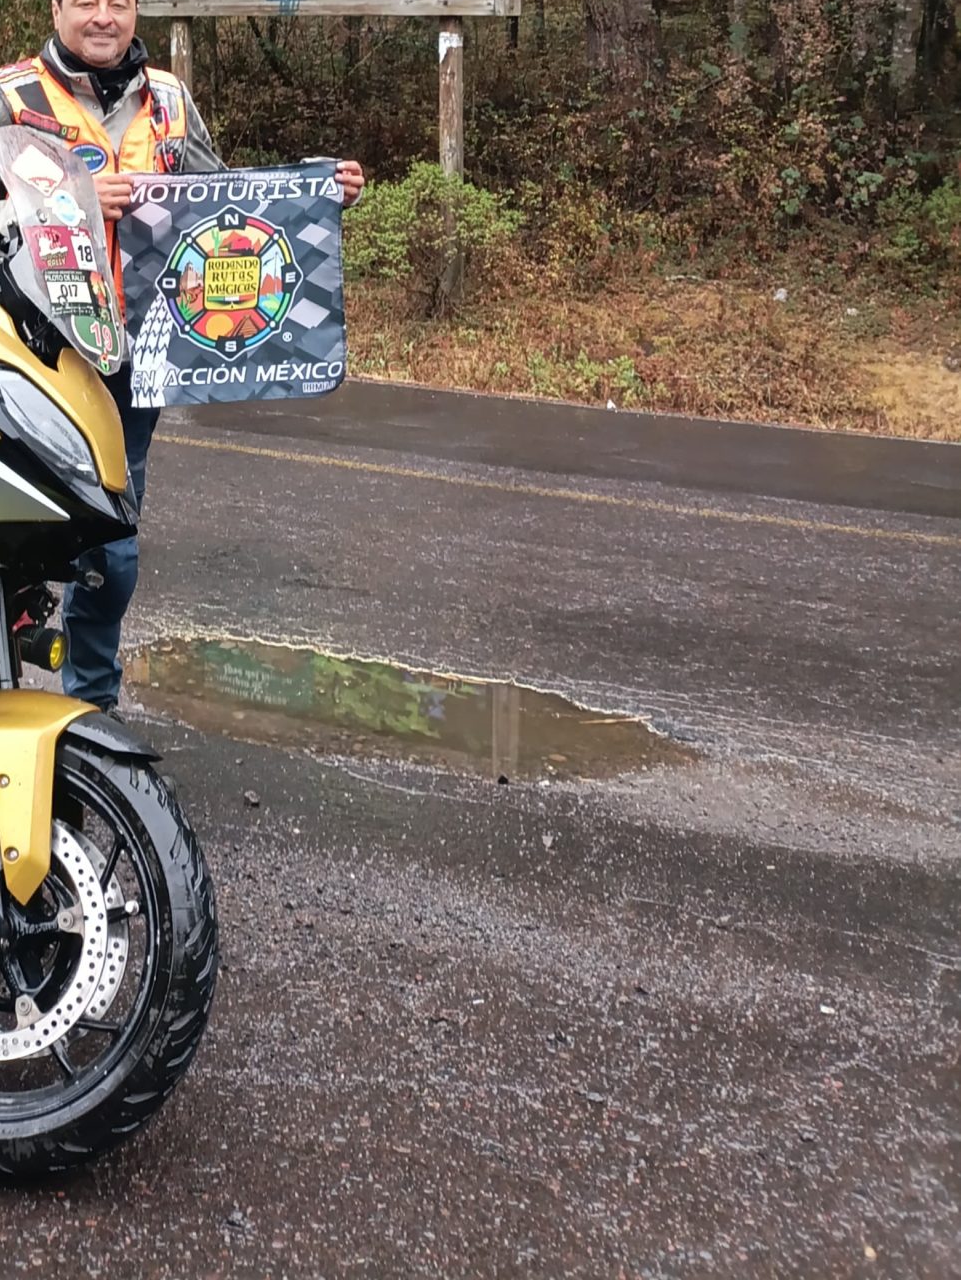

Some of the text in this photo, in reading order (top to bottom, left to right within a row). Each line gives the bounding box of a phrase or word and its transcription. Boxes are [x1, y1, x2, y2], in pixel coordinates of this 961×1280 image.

[130, 176, 340, 203] MOTOTURISTA
[224, 213, 239, 226] N
[78, 245, 93, 262] 18
[285, 272, 296, 283] E
[90, 321, 113, 351] 19
[225, 341, 237, 352] S
[163, 364, 246, 386] ACCIÓN
[255, 360, 343, 381] MÉXICO
